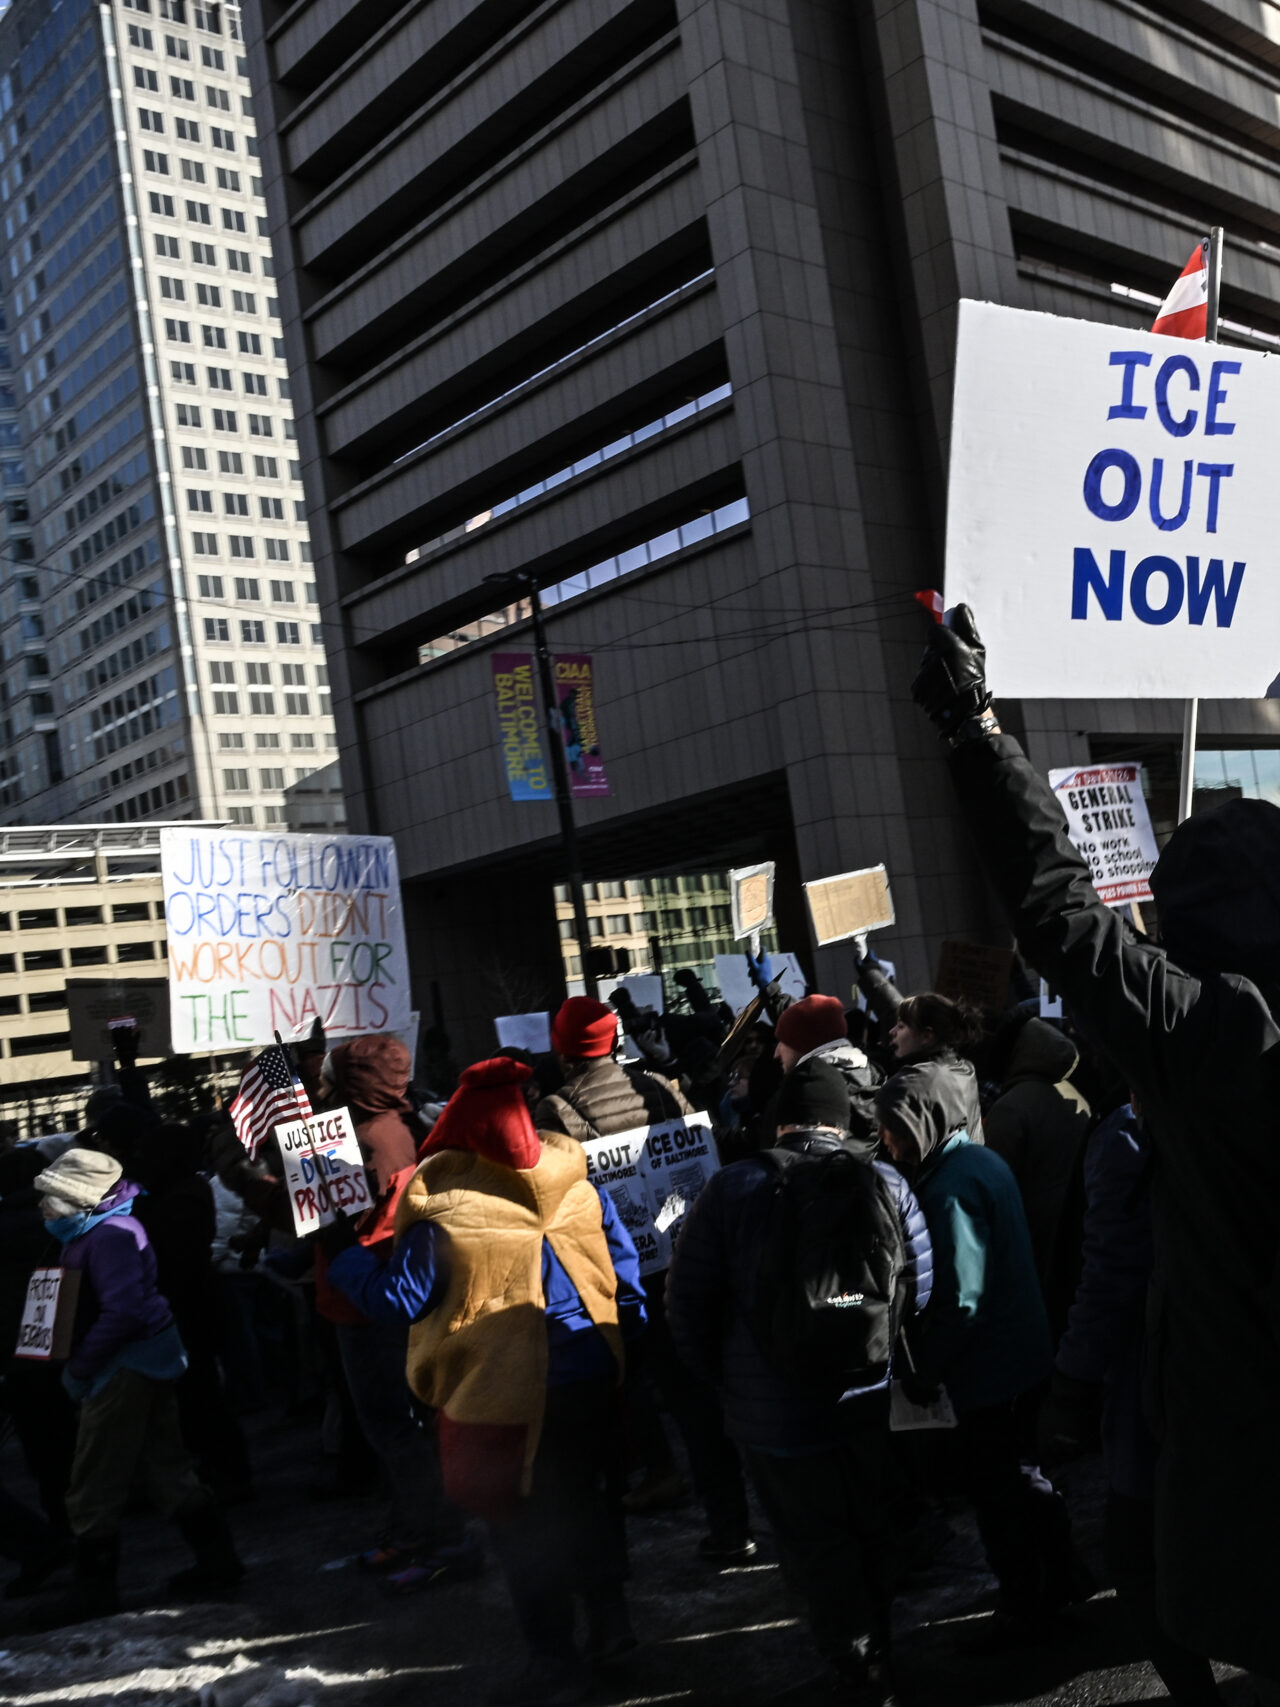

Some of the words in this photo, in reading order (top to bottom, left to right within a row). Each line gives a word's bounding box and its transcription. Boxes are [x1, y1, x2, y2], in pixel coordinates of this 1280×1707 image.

[1107, 351, 1242, 437] ICE
[1083, 448, 1234, 533] OUT
[1071, 547, 1246, 628] NOW
[496, 673, 528, 781] BALTIMORE
[514, 664, 541, 760] WELCOME
[528, 764, 548, 790] TO
[1068, 784, 1134, 810] GENERAL
[1081, 807, 1136, 833] STRIKE
[173, 838, 251, 889] JUST
[259, 840, 390, 891] FOLLOWIN
[1077, 841, 1096, 854] No
[1100, 837, 1129, 850] work
[1104, 847, 1142, 864] school
[1108, 860, 1157, 878] shoppin
[329, 941, 396, 985] FOR
[180, 989, 255, 1043] THE
[269, 981, 389, 1036] NAZIS
[284, 1115, 346, 1151] JUSTICE
[646, 1133, 673, 1158] ICE
[673, 1126, 704, 1150] OUT
[598, 1144, 632, 1171] OUT
[651, 1157, 662, 1170] OF
[666, 1144, 709, 1166] BALTIMORE!
[294, 1171, 367, 1222] PROCESS
